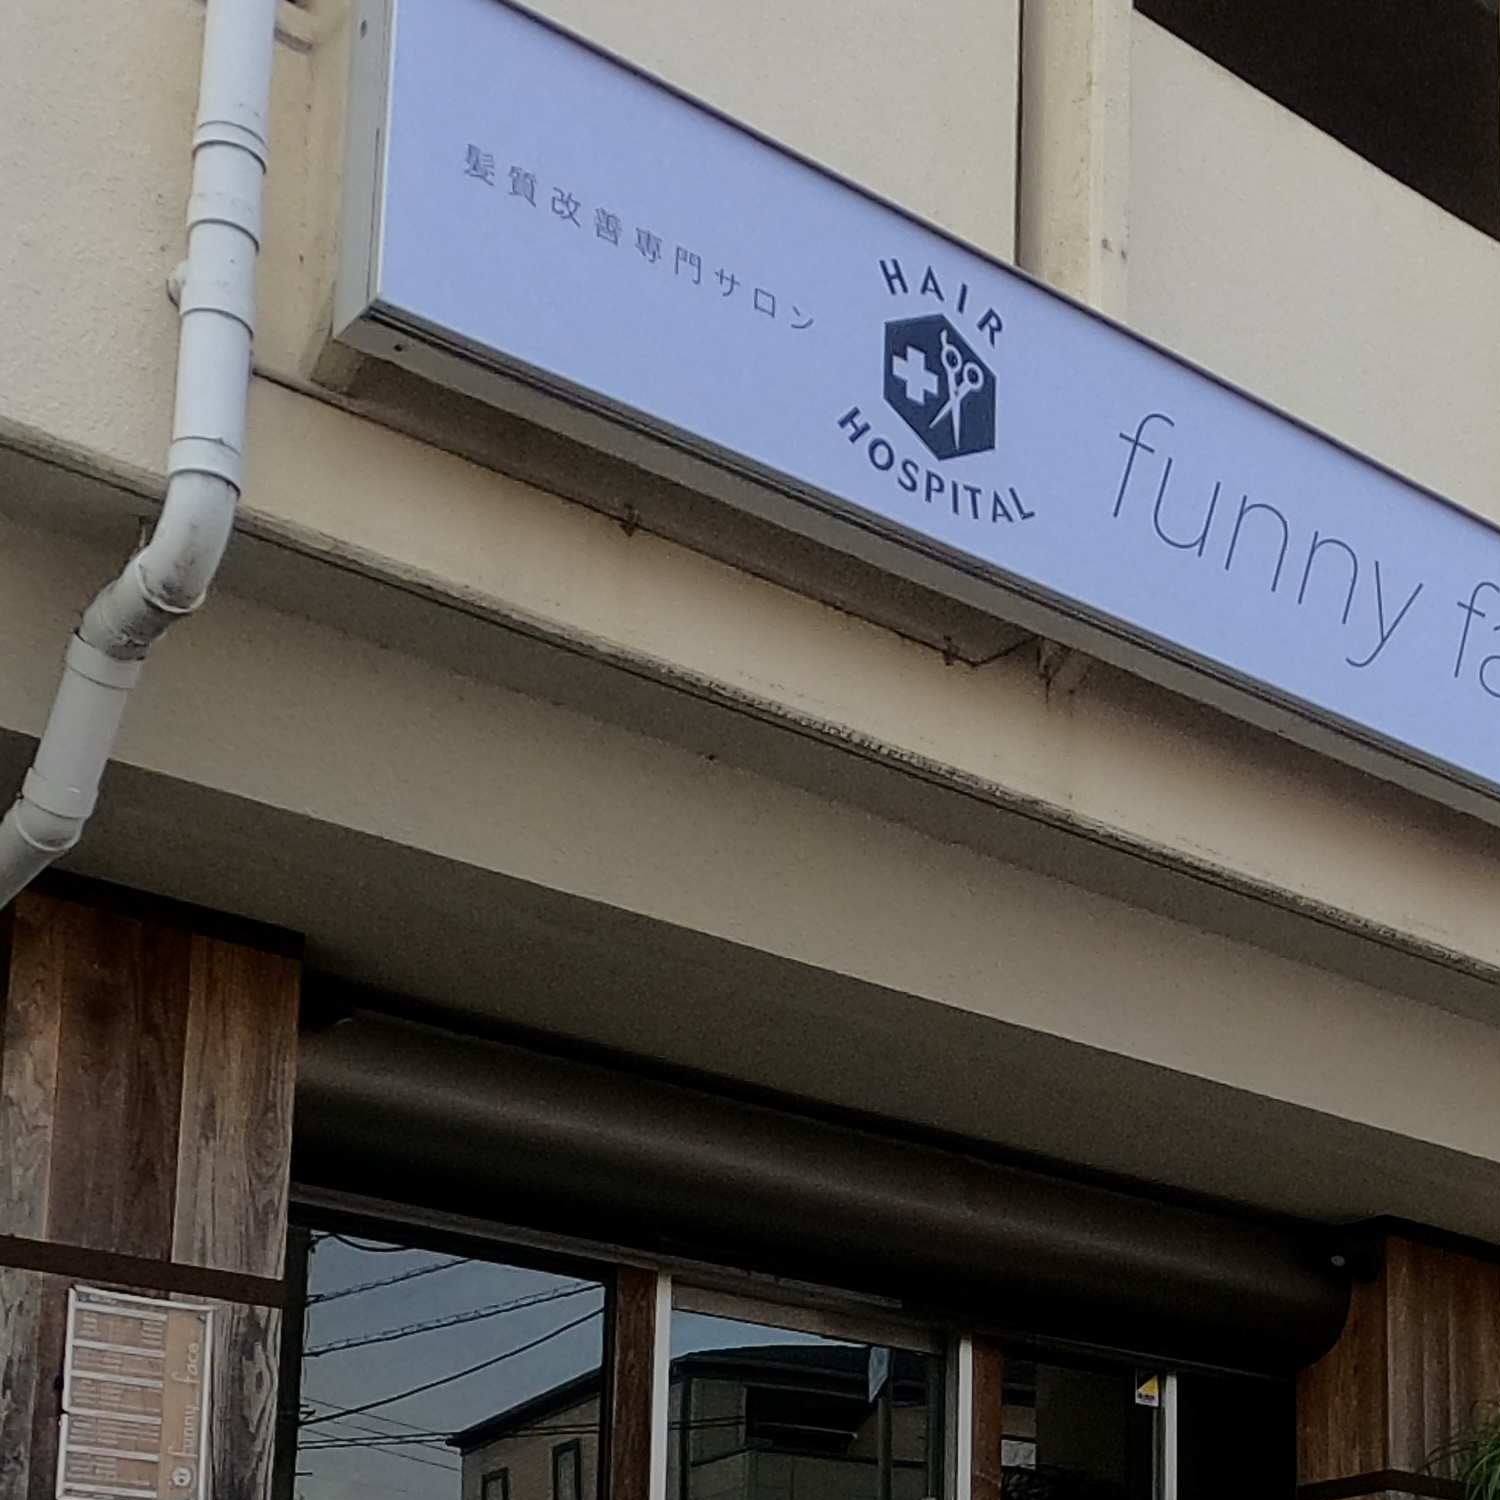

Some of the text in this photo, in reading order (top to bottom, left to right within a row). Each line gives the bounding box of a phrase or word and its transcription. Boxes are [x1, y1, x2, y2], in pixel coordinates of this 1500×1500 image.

[464, 142, 814, 330] 髪質改善専門サロン
[879, 258, 1003, 349] HAIR
[837, 406, 1035, 524] HOSPITAL
[1113, 412, 1424, 668] funny
